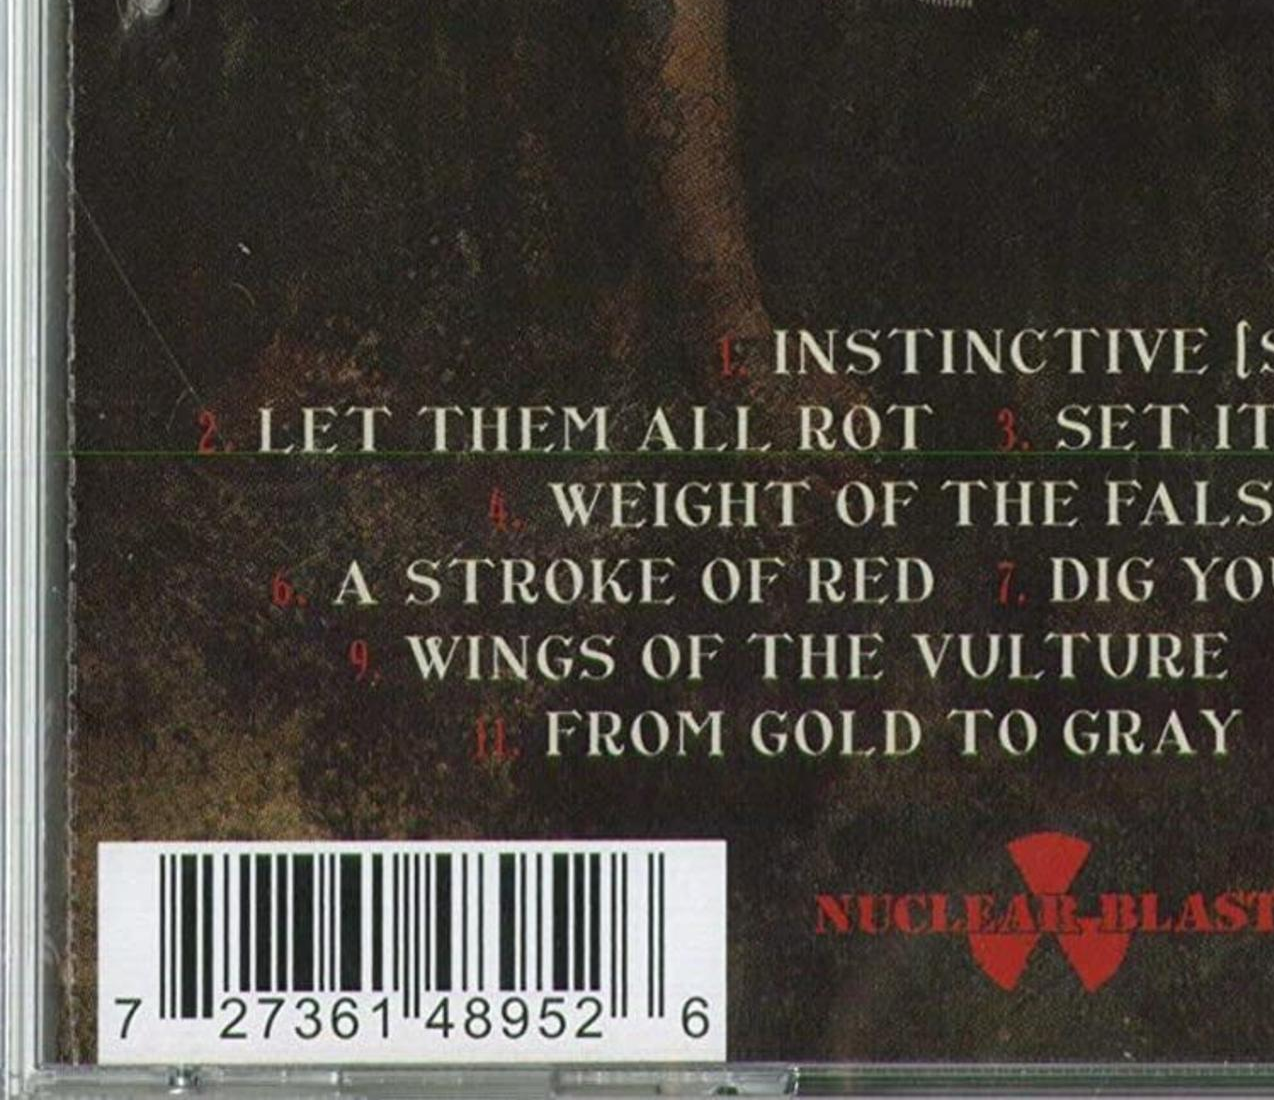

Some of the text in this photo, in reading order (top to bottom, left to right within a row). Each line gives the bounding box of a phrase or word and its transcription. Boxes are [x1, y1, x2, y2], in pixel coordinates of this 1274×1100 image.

[774, 327, 1209, 375] INSTINCTIVE
[258, 405, 393, 453] LET
[418, 405, 609, 453] THEM
[637, 404, 772, 452] ALL
[799, 403, 933, 451] ROT
[1056, 403, 1189, 451] SET
[548, 481, 811, 529] WEIGHT
[835, 481, 918, 529] OF
[940, 481, 1079, 529] THE
[332, 560, 378, 605] A
[404, 557, 677, 606] STROKE
[701, 557, 785, 606] OF
[806, 556, 935, 604] RED
[1050, 556, 1154, 603] DIG
[405, 634, 616, 682] WINGS
[641, 634, 724, 682] OF
[747, 634, 884, 682] THE
[911, 633, 1229, 680] VULTURE
[545, 710, 725, 758] FROM
[750, 710, 923, 758] GOLD
[946, 710, 1038, 758] TO
[1061, 709, 1243, 757] GRAY
[815, 891, 1084, 936] NUCLEAR
[114, 997, 711, 1040] 7 27361 48952 6
